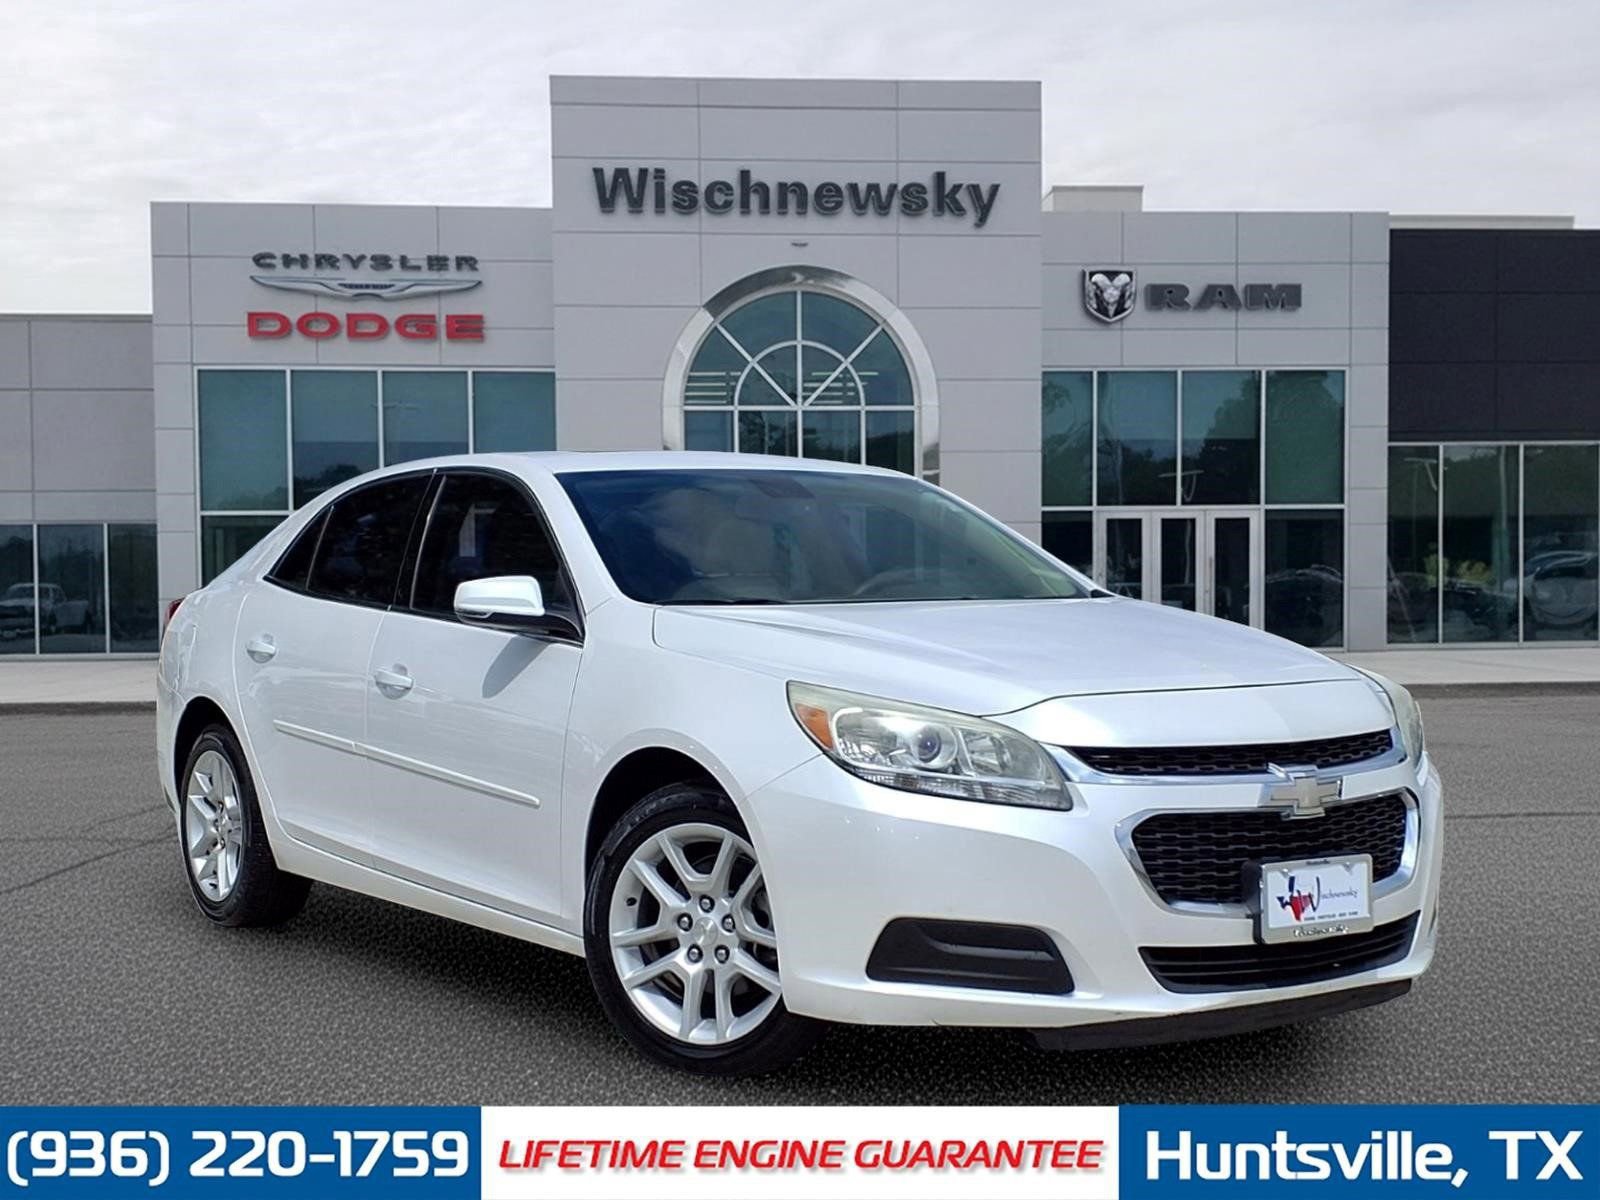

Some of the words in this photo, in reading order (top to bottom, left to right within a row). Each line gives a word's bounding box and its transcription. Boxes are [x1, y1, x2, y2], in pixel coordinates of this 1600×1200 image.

[592, 167, 1000, 228] Wischnewsky
[252, 252, 479, 272] CHRYSLER
[1144, 283, 1302, 311] RAM
[247, 312, 484, 341] DODGE
